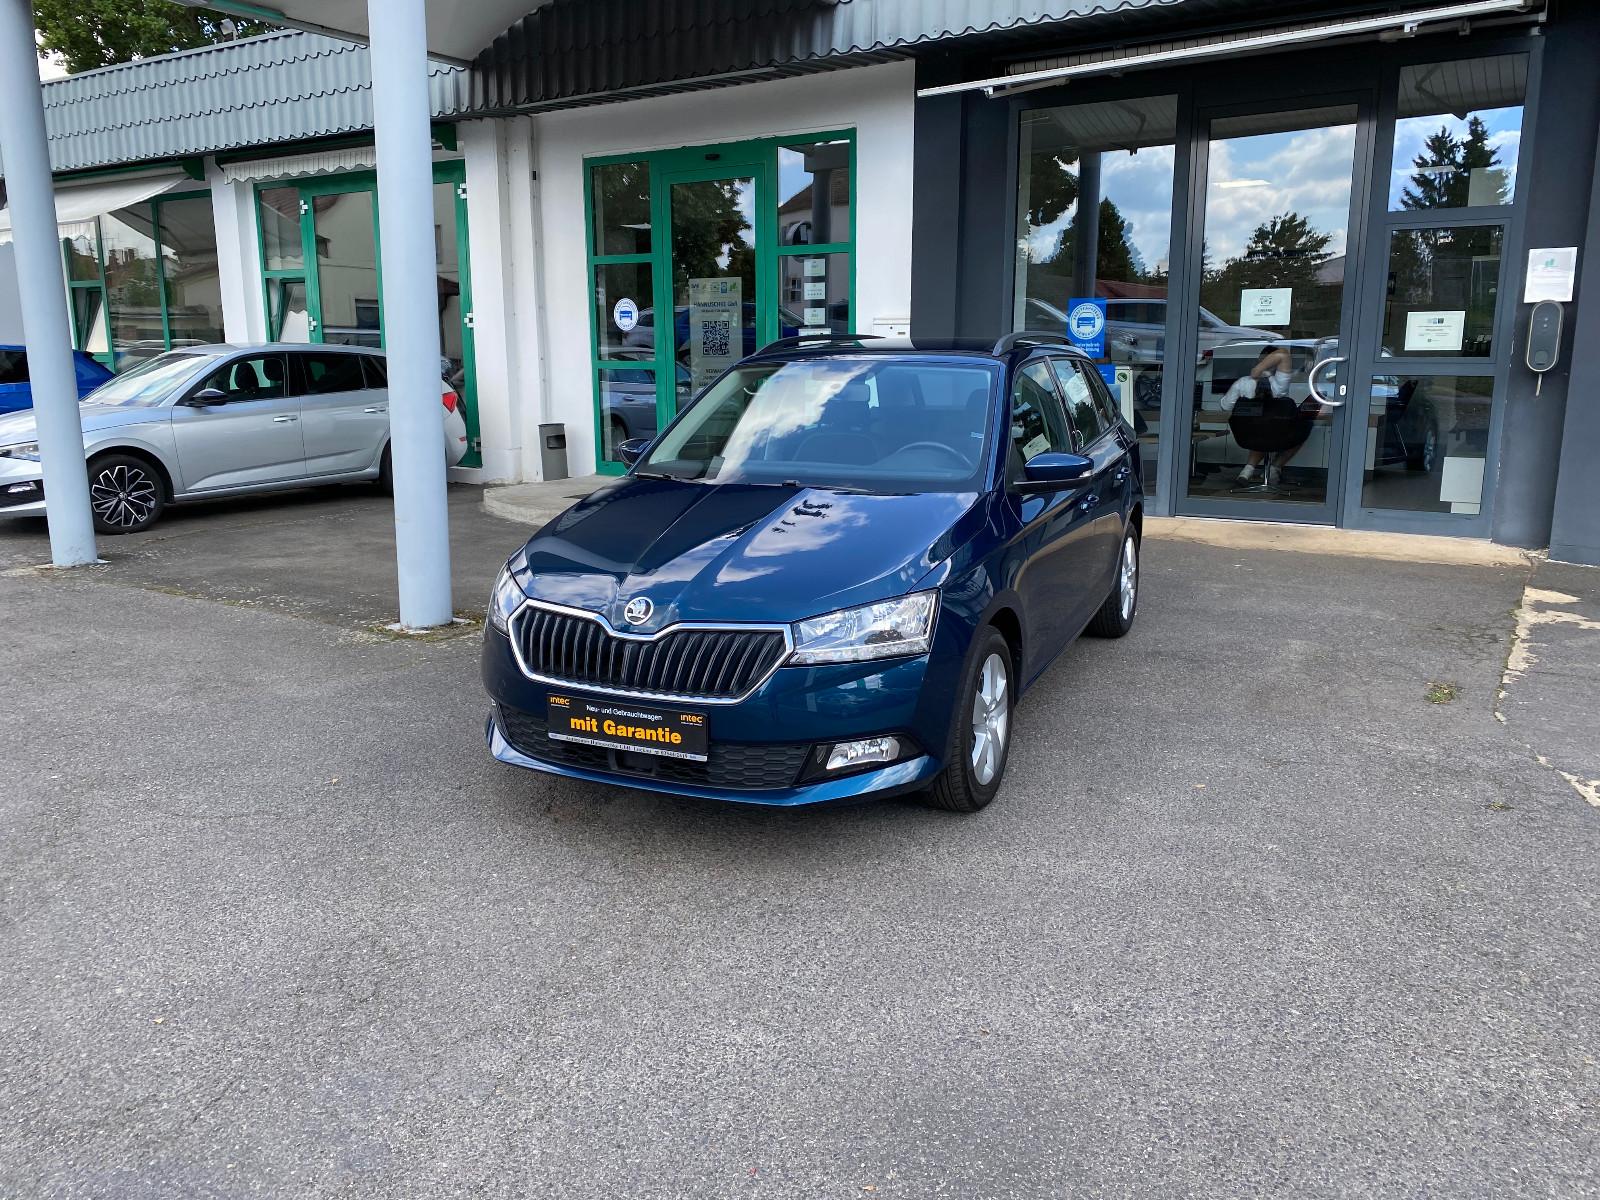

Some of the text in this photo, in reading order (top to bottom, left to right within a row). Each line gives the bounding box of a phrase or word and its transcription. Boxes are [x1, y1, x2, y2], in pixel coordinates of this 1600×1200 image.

[586, 704, 600, 712] Neu-
[612, 709, 663, 722] Gebrauchtwagen
[680, 714, 703, 723] intec
[570, 716, 598, 732] mit
[603, 719, 682, 744] Garantie
